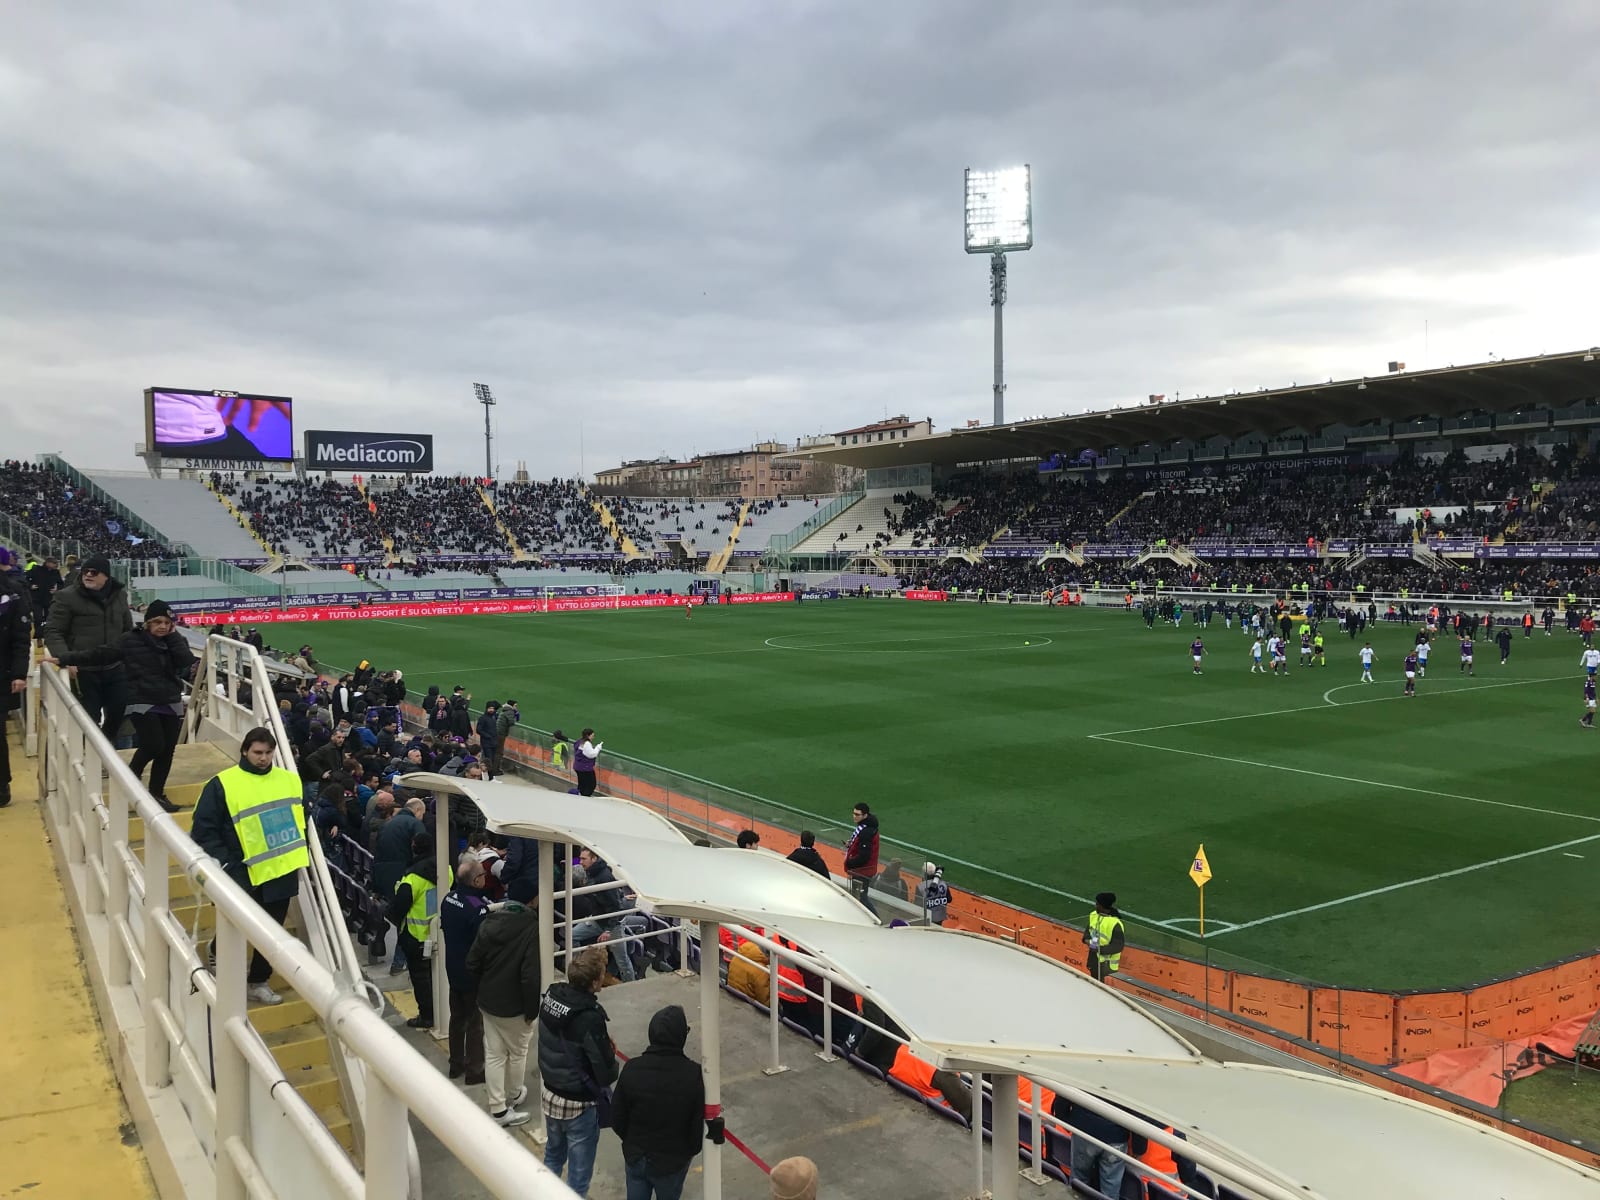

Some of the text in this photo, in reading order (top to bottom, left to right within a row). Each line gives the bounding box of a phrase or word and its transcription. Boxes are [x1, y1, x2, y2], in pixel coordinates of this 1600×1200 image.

[317, 443, 415, 463] Mediacom
[186, 458, 264, 470] SAMMONTANA
[801, 592, 829, 600] Mediacm
[328, 611, 356, 619] TUTTO
[358, 610, 370, 618] LO
[371, 609, 399, 617] SPORT
[421, 607, 464, 615] OLYBET.TV
[185, 616, 217, 624] BET.TV
[1243, 1006, 1268, 1018] NGM
[1323, 1021, 1350, 1031] NGM
